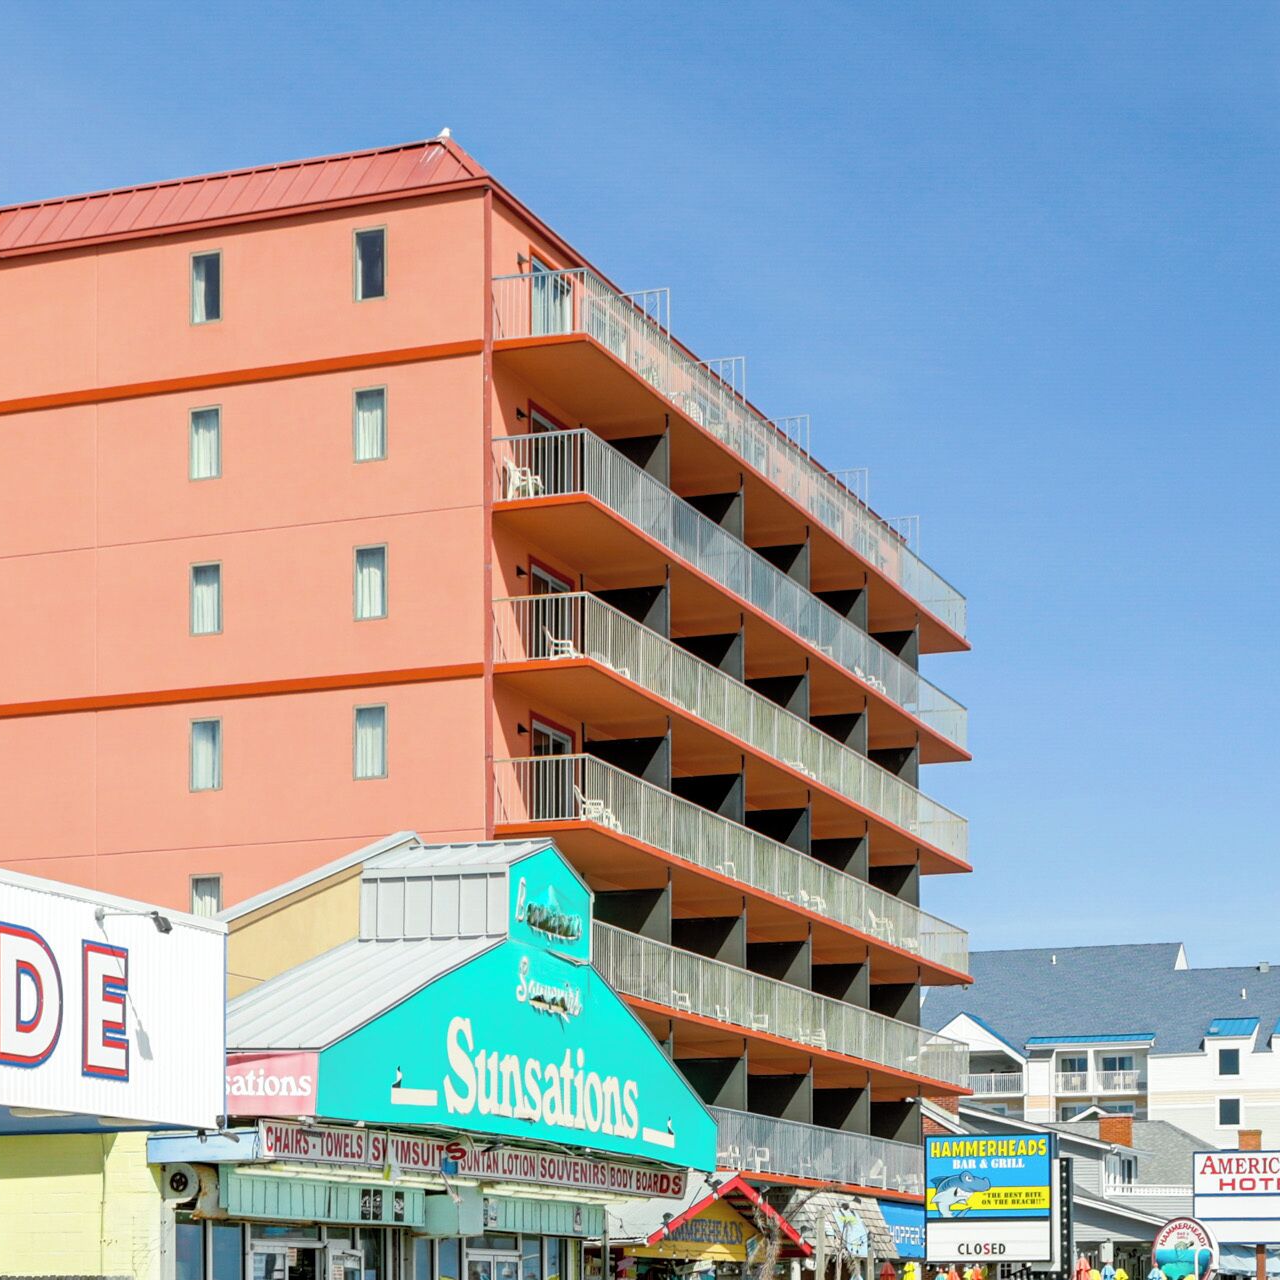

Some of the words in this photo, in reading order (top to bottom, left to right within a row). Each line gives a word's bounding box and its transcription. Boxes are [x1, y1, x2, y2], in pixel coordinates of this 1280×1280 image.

[443, 1017, 638, 1139] Sunsations
[265, 1126, 309, 1155] CHAIRS
[320, 1131, 363, 1159] TOWELS
[930, 1138, 1048, 1158] HAMMERHEADS
[461, 1150, 499, 1174] SUNTAN
[502, 1152, 536, 1178] LOTION
[540, 1156, 606, 1185] SOUVENIRS
[952, 1159, 976, 1169] BAR
[979, 1159, 988, 1169] &
[991, 1158, 1025, 1168] GRILL
[610, 1167, 633, 1189] BODY
[636, 1172, 683, 1195] BOARDS
[957, 1243, 1006, 1255] CLOSED
